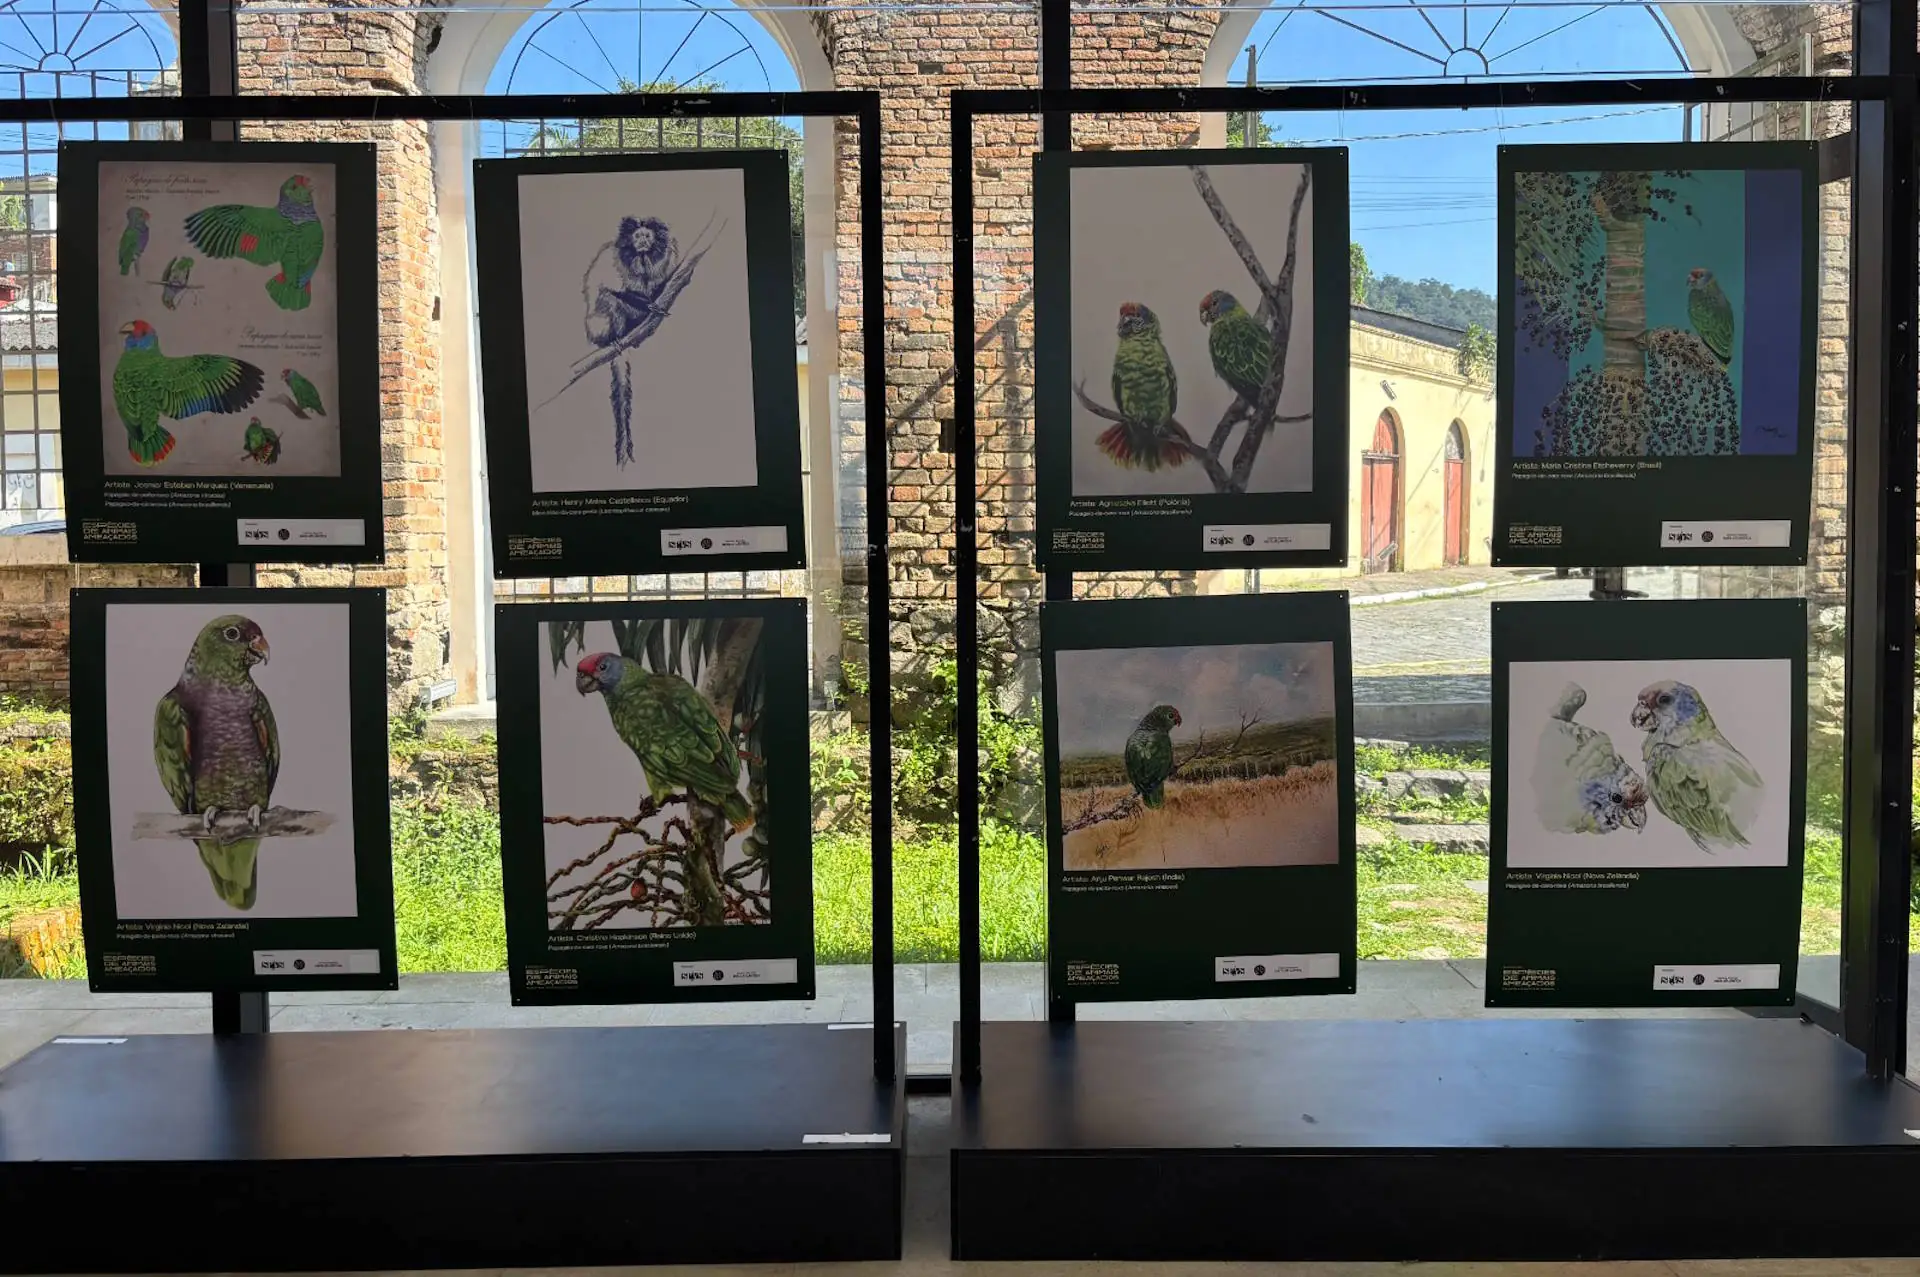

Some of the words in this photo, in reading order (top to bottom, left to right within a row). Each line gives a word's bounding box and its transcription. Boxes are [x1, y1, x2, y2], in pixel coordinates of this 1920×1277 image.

[1563, 462, 1591, 470] Cristina
[1593, 462, 1635, 470] Etcheverry
[1636, 462, 1661, 471] (Brasil)
[164, 481, 195, 490] Esteban
